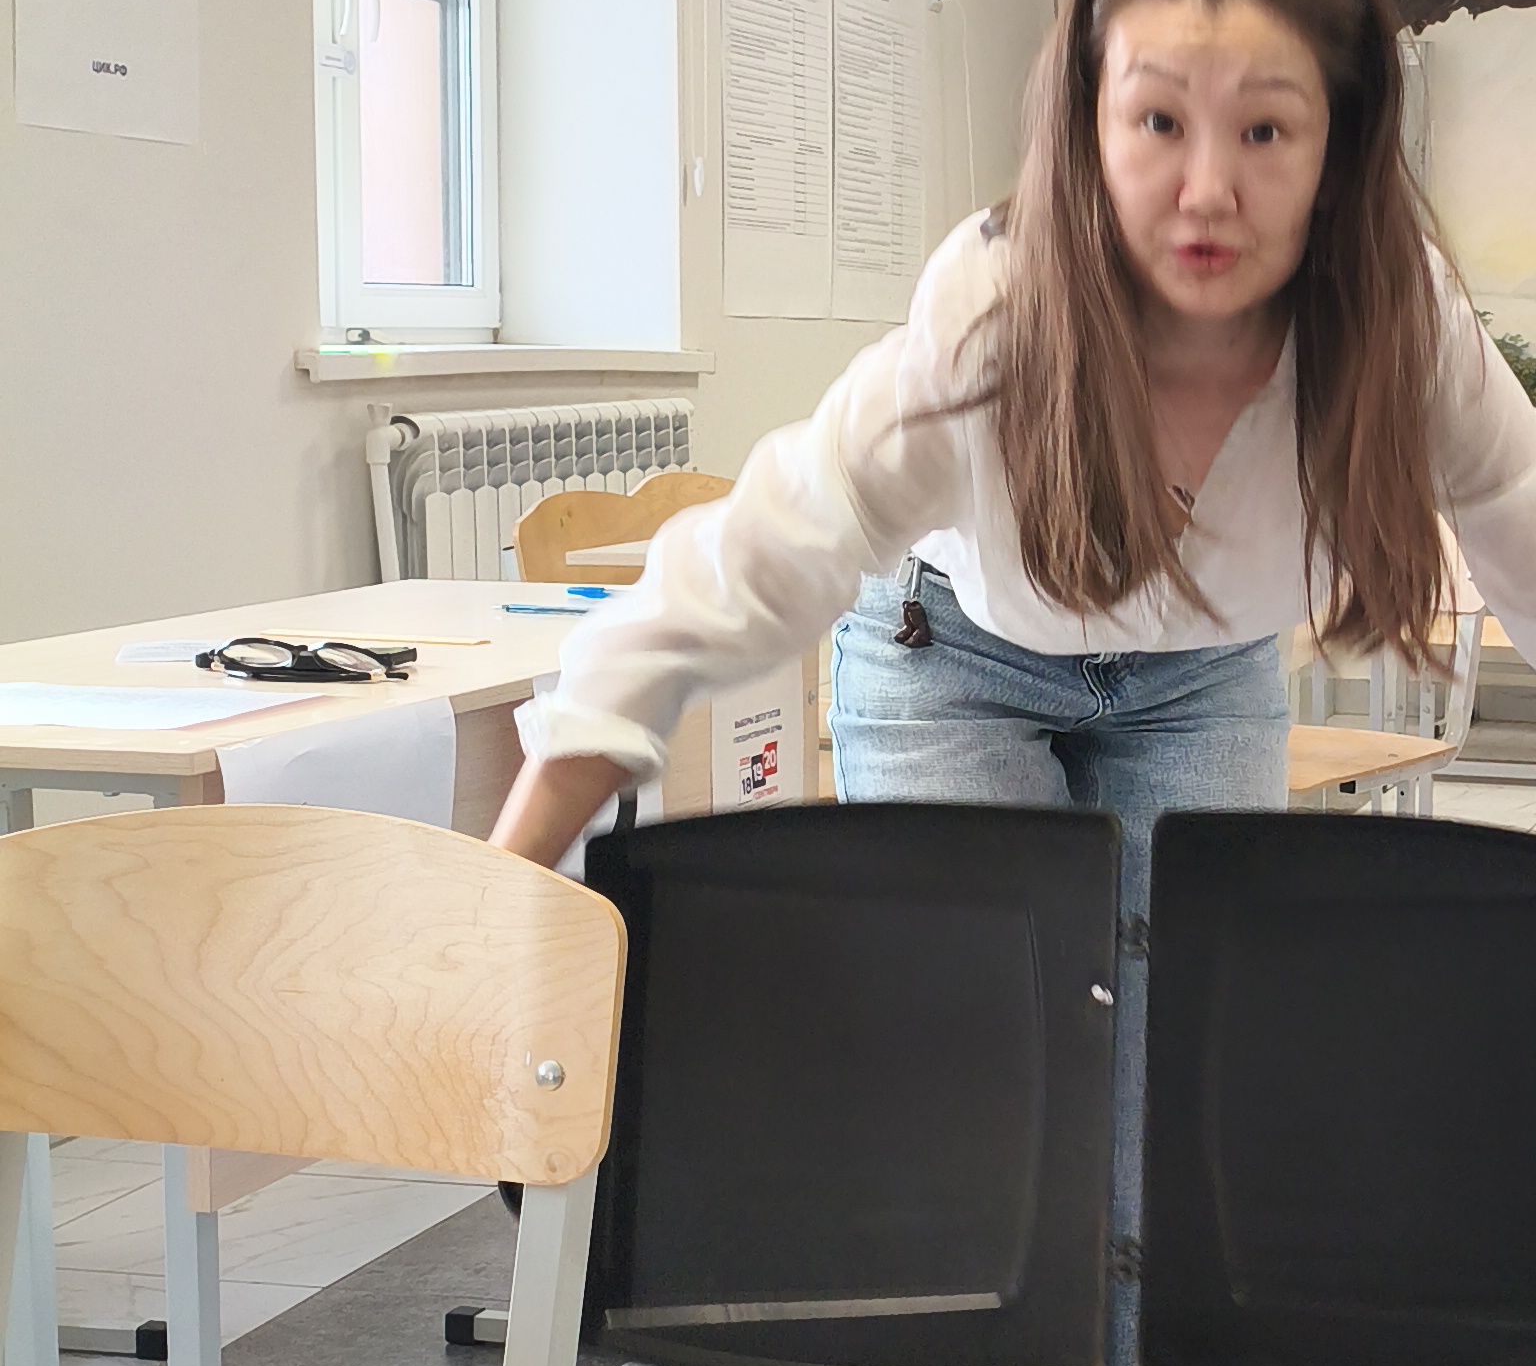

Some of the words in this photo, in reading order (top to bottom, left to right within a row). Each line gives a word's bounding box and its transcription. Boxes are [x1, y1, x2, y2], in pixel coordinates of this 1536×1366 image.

[742, 777, 751, 795] 18
[753, 762, 763, 781] 19
[763, 749, 776, 769] 20
